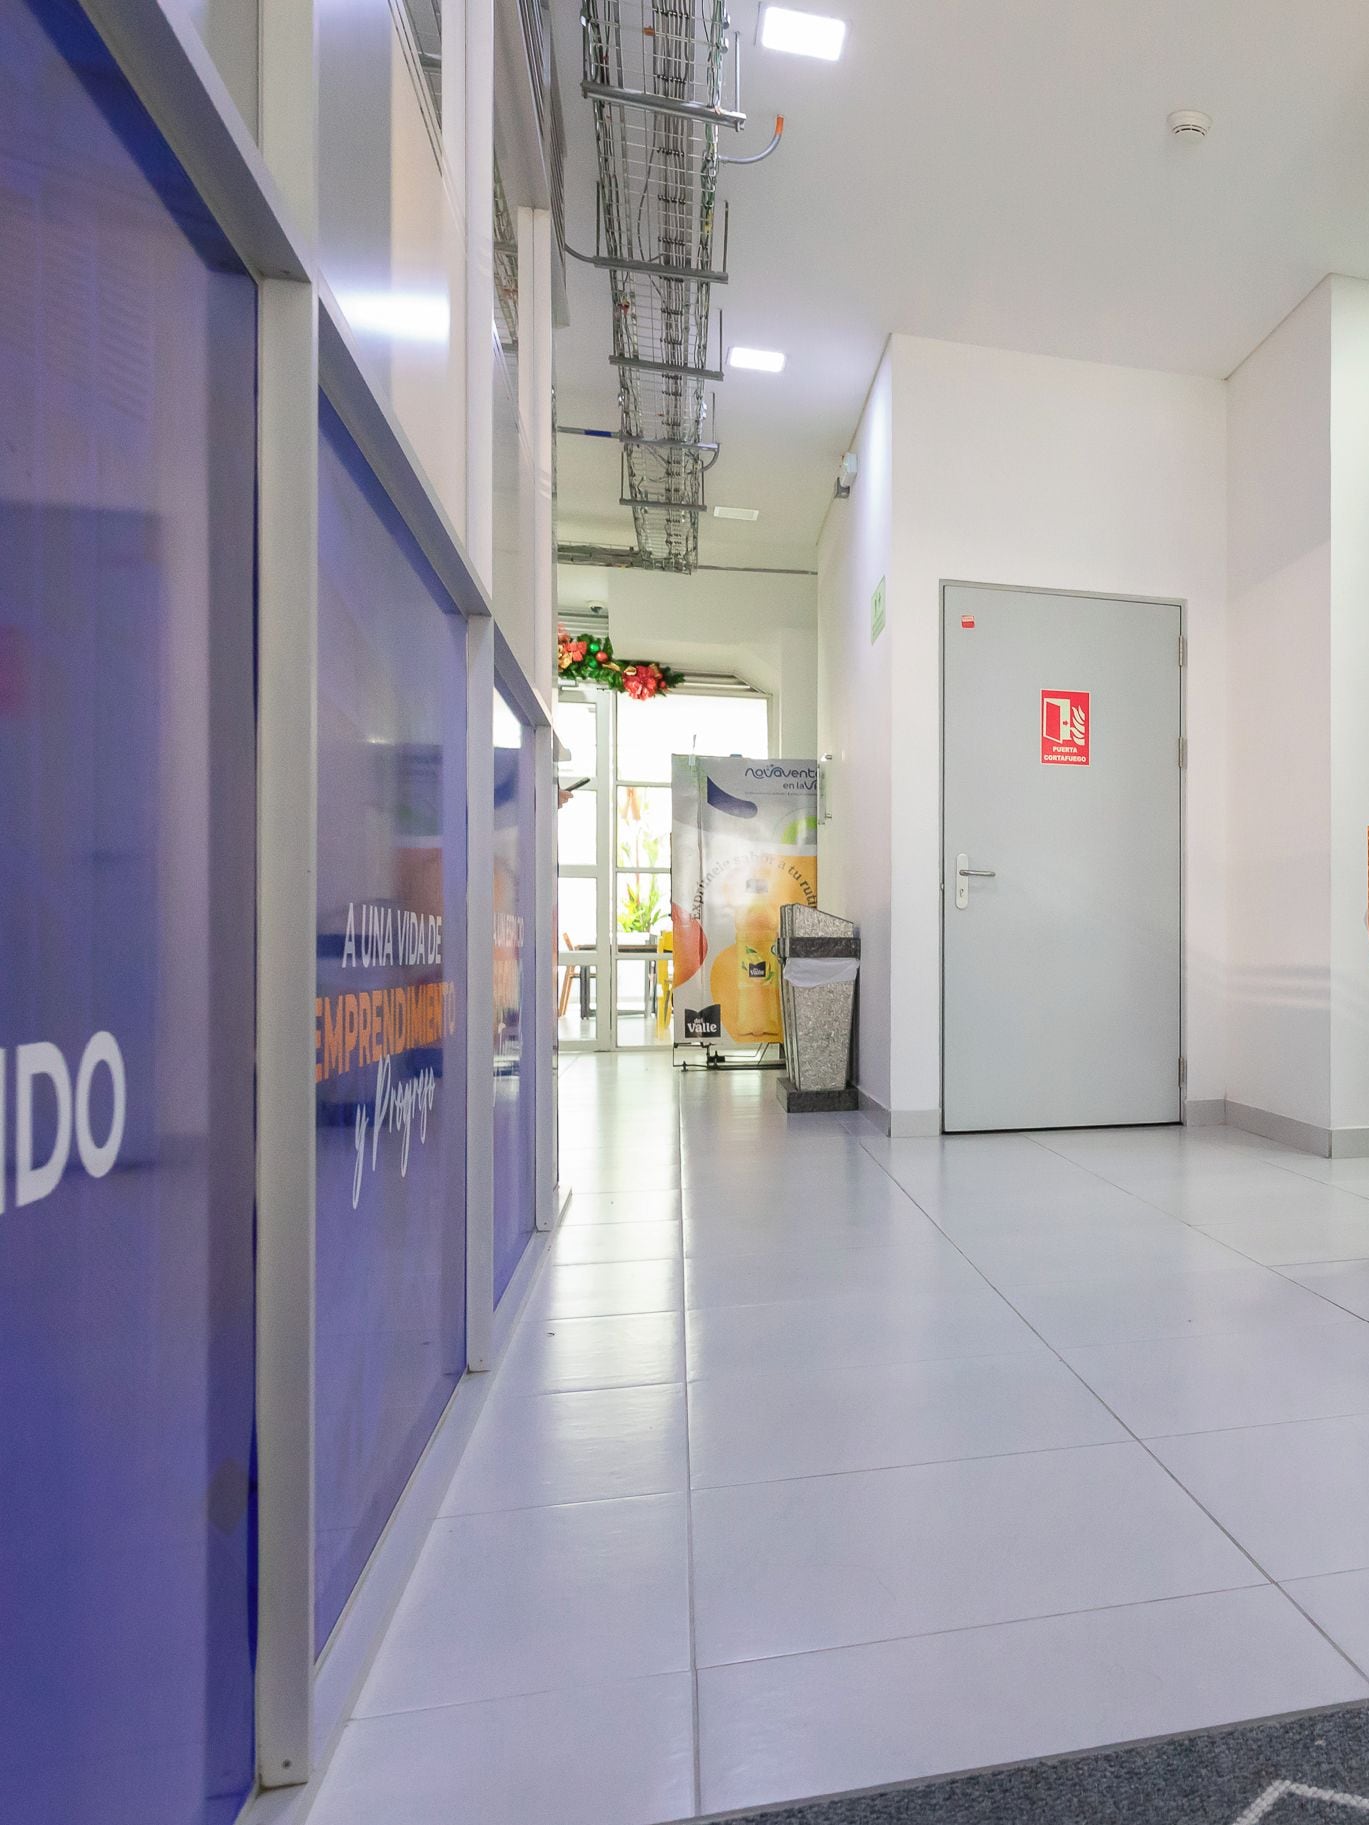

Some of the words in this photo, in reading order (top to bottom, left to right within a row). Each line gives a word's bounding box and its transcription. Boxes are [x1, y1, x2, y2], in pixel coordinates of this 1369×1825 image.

[745, 764, 817, 779] novavent
[788, 866, 802, 880] tu
[342, 902, 356, 968] A
[361, 904, 393, 968] UNA
[397, 910, 426, 966] VIDA
[427, 914, 442, 965] DE
[687, 1023, 717, 1033] Valle
[352, 1104, 369, 1210] y
[372, 1053, 436, 1178] Progreso
